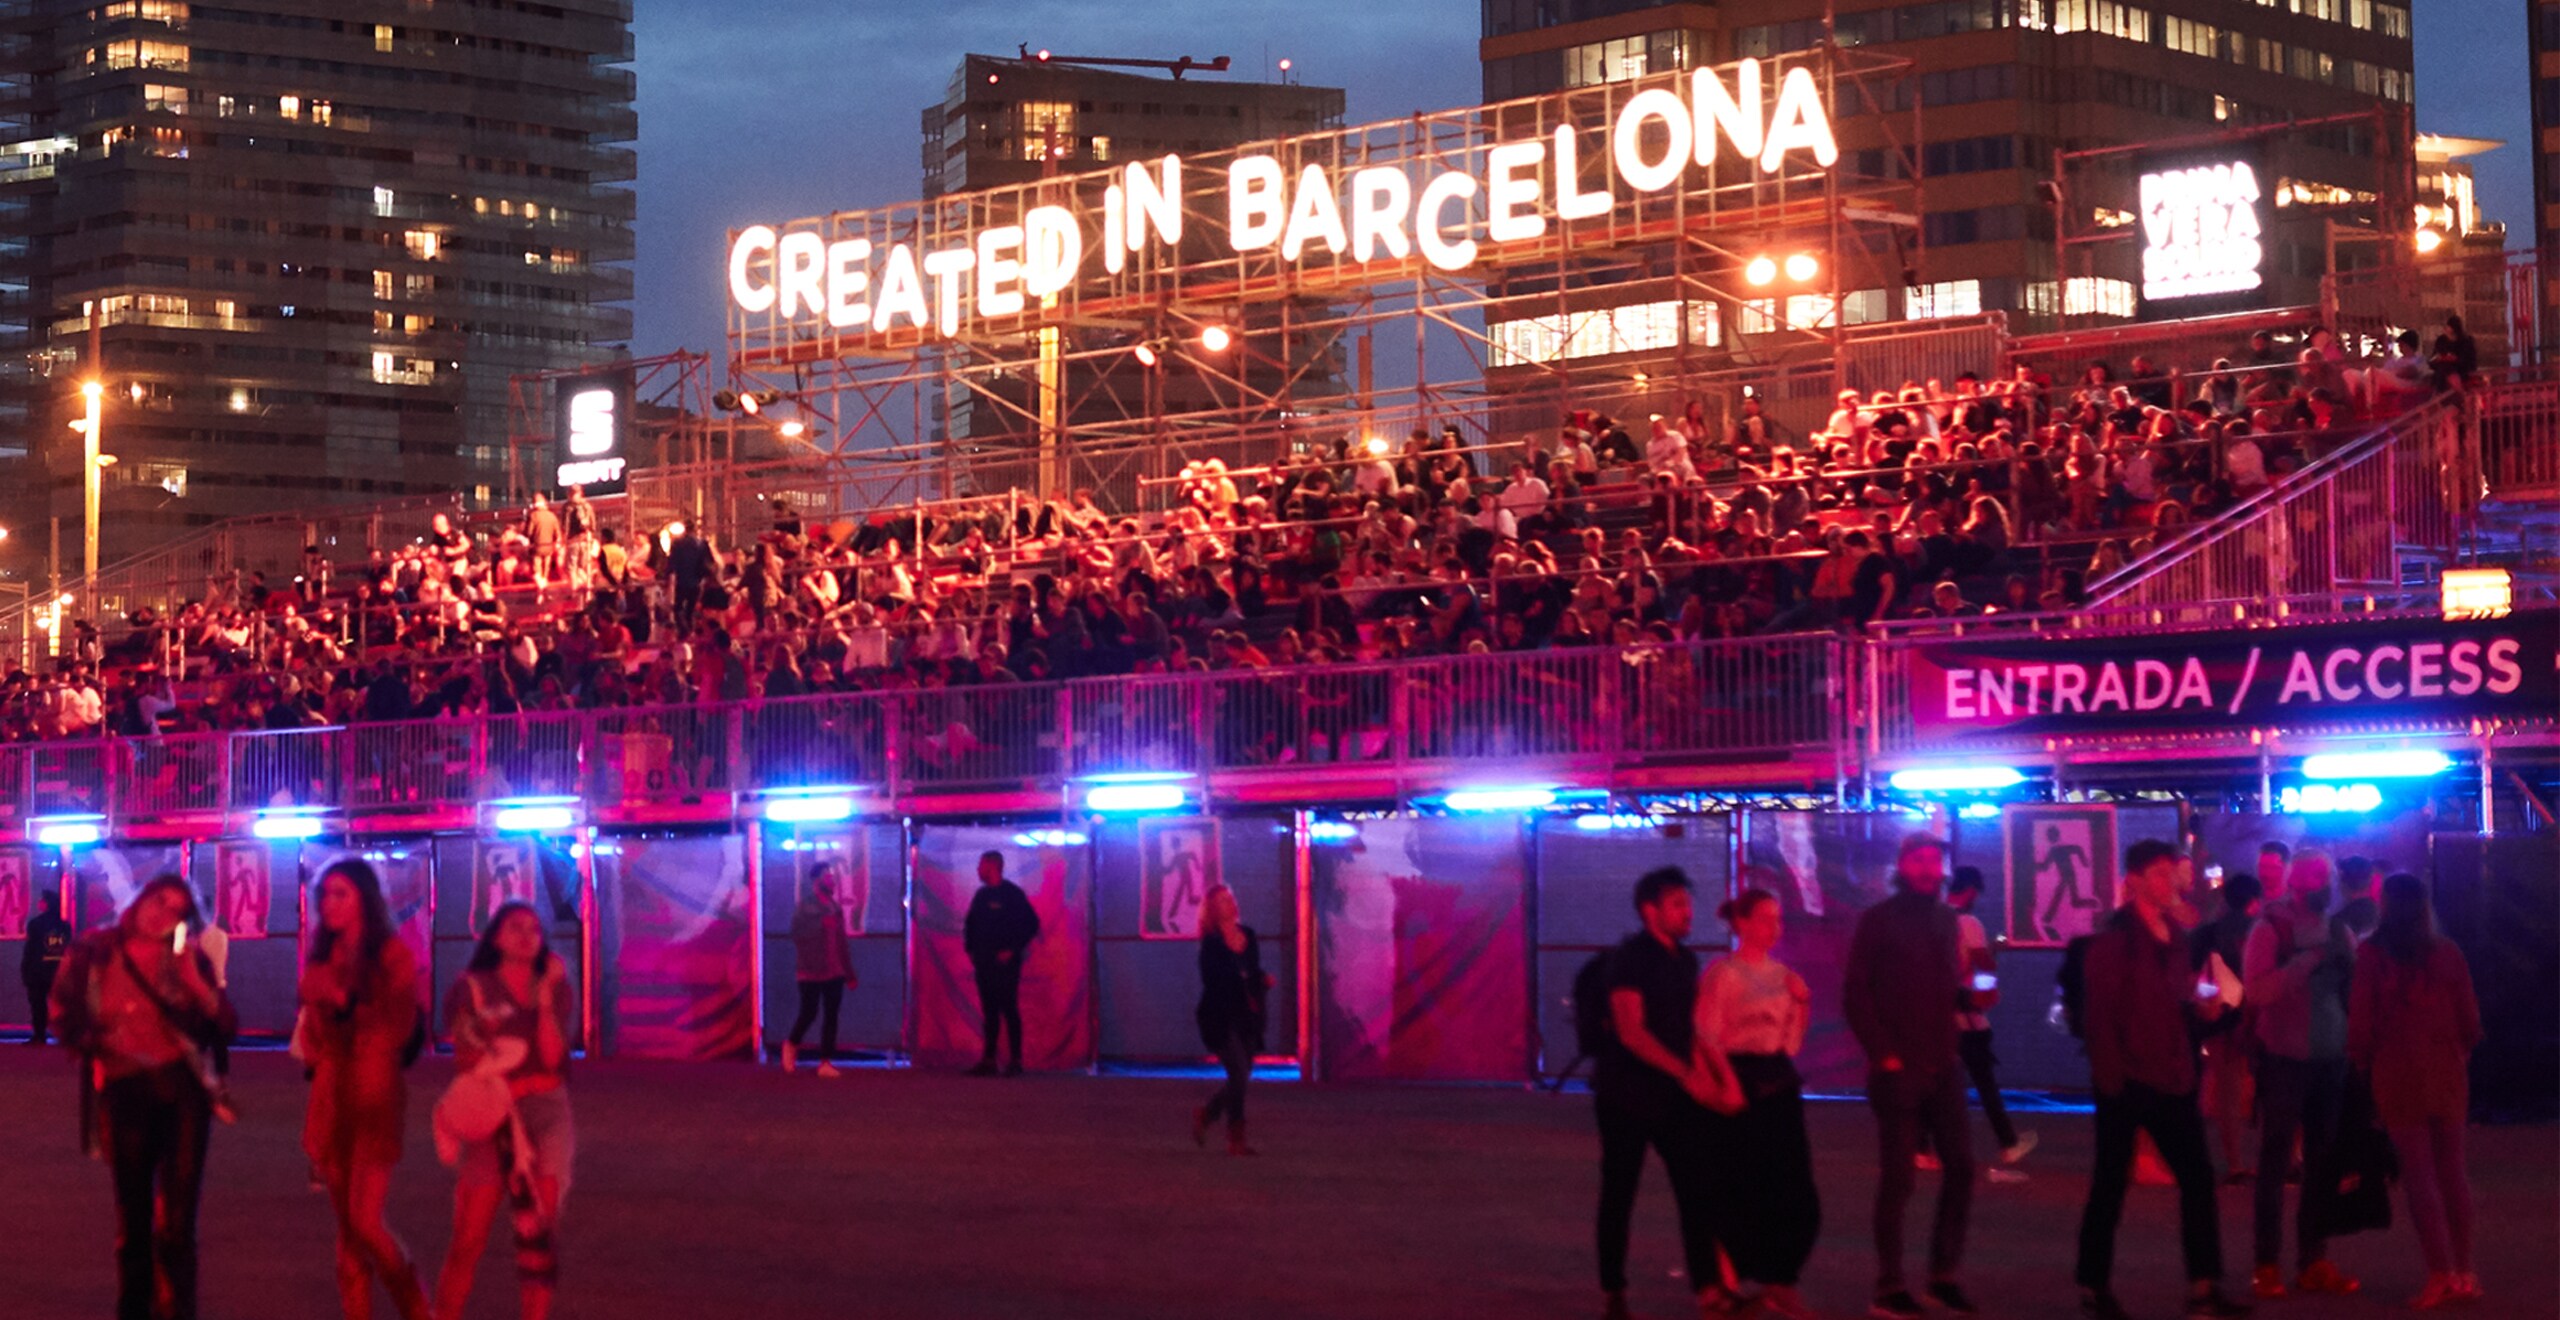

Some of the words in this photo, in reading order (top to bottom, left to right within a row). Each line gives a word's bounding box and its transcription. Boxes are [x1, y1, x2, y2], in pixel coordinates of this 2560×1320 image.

[728, 204, 1083, 339] CREATED
[1103, 153, 1183, 276] IN
[1229, 57, 1838, 271] BARCELONA
[1946, 655, 2213, 719] ENTRADA
[2229, 646, 2262, 715] /
[2278, 638, 2523, 704] ACCESS
